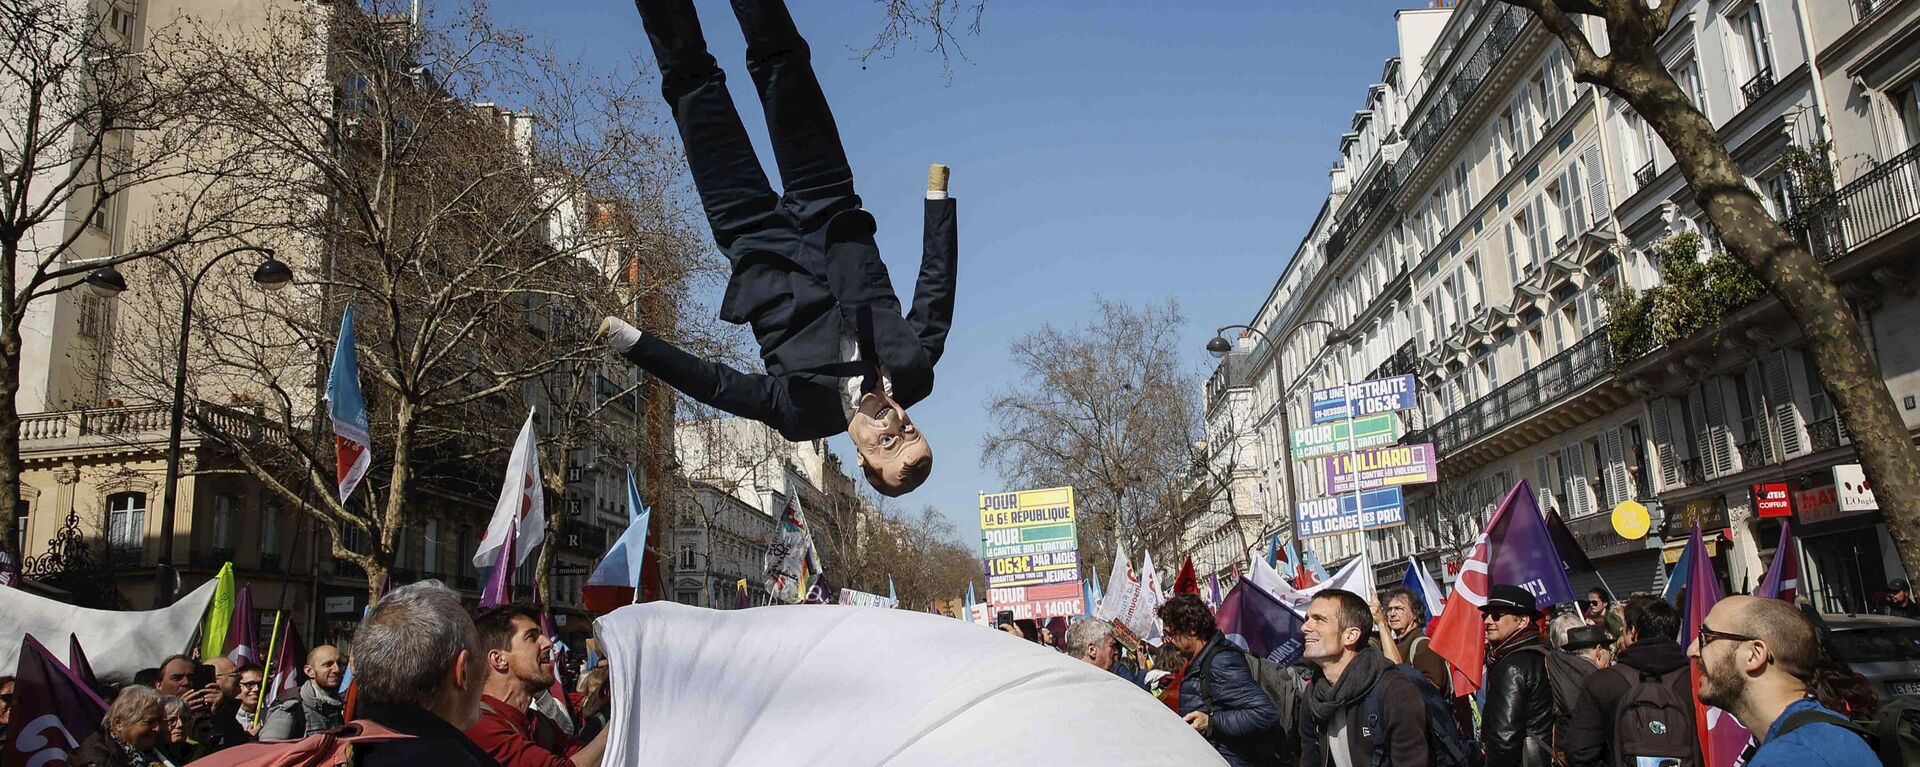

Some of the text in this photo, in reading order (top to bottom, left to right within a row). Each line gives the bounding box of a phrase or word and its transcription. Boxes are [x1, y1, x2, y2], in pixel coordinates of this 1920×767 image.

[1313, 377, 1407, 402] PAS UNE RETRAITE
[1314, 406, 1347, 419] EN-DESSOU
[1295, 425, 1333, 447] POUR
[1304, 443, 1336, 457] CANTINE
[1357, 433, 1393, 448] GRATUITE
[1362, 470, 1384, 480] CONTRE
[984, 493, 1018, 511] POUR
[1759, 490, 1786, 500] ATEIS
[1298, 497, 1338, 521] POUR
[1760, 501, 1788, 509] COIFFEUR
[985, 513, 994, 523] LA
[1011, 506, 1071, 524] RÉPUBLIQUE
[1301, 522, 1310, 532] LE
[1312, 515, 1359, 534] BLOCAGE
[1377, 507, 1402, 525] PRIX
[985, 529, 1020, 547] POUR
[993, 545, 1022, 557] CANTINE
[1032, 553, 1050, 566] PAR
[1052, 551, 1076, 565] MOIS
[559, 565, 588, 575] musique
[1044, 569, 1078, 583] JEUNES
[991, 586, 1025, 604] POUR
[1044, 599, 1081, 617] 1400€
